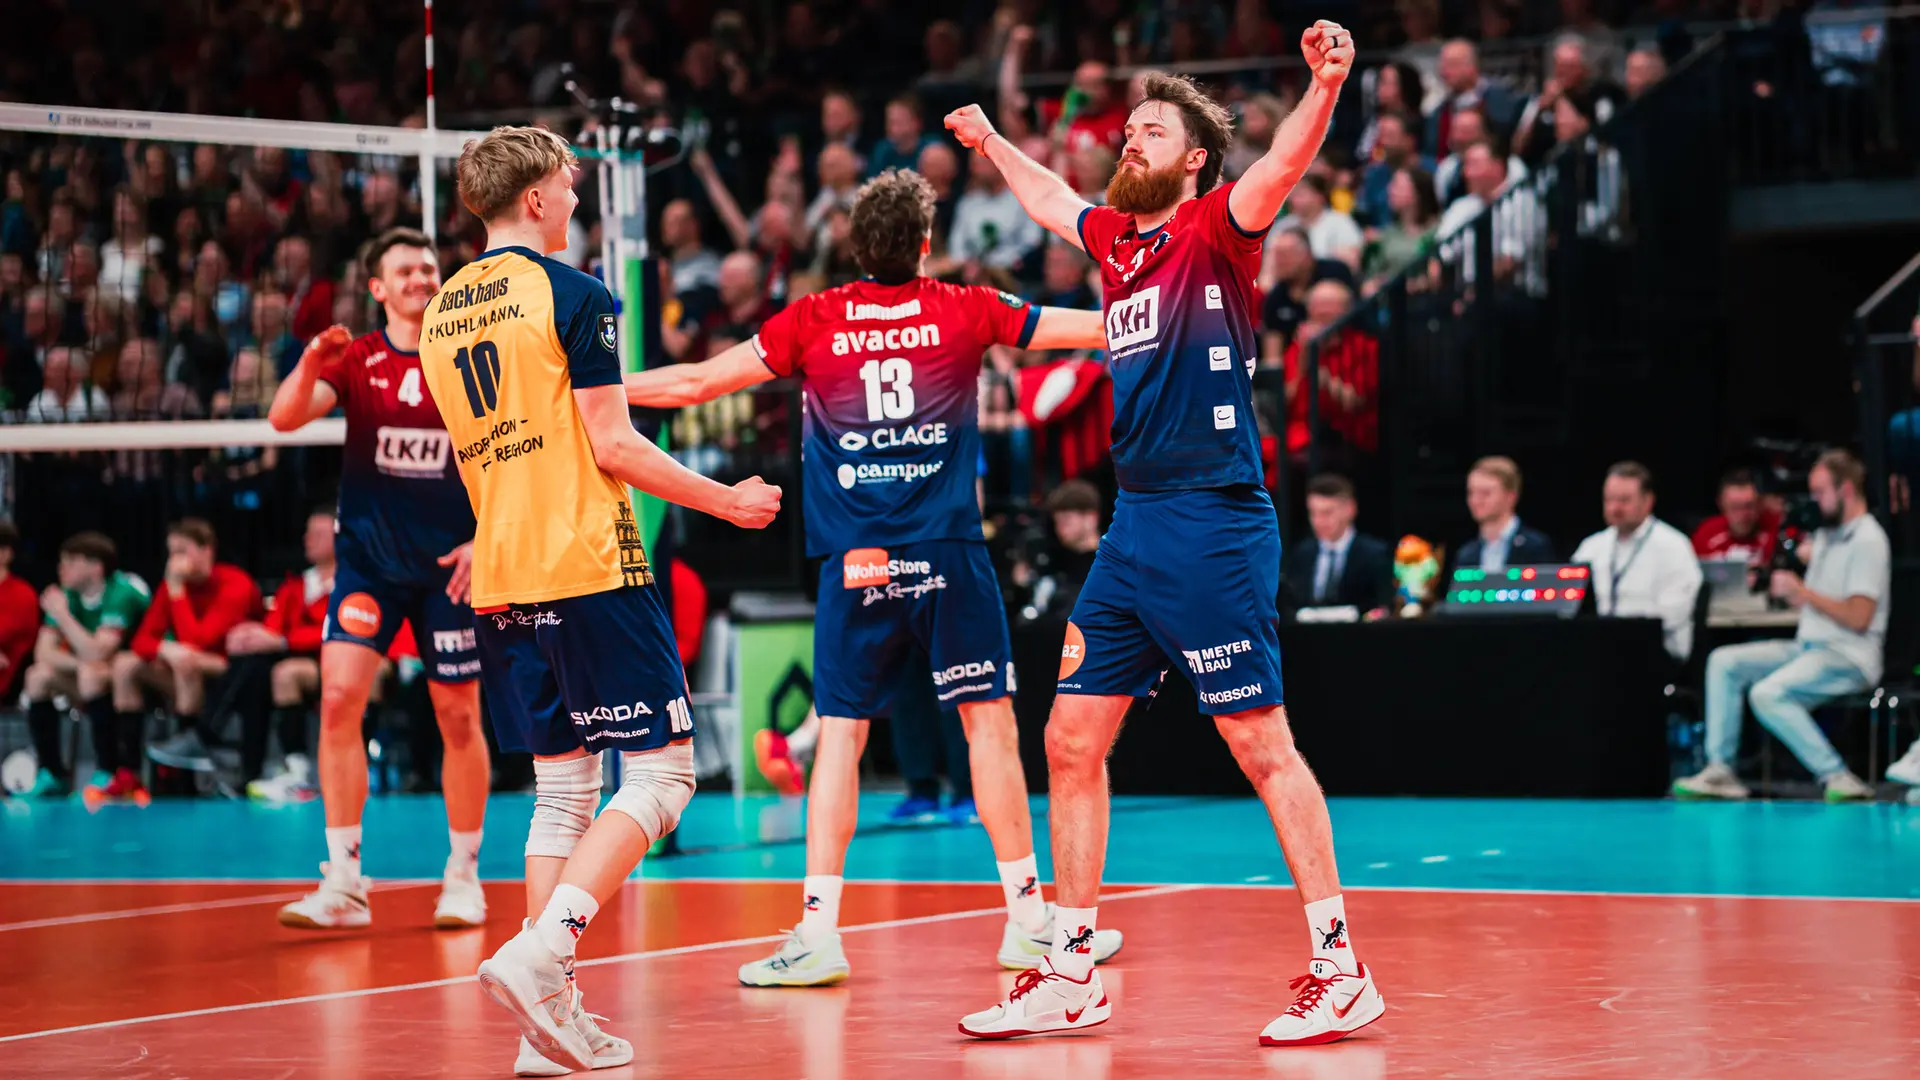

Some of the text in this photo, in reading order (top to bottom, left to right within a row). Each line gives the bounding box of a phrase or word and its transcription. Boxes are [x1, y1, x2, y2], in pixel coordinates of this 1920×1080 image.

[438, 277, 509, 313] Backhaus
[1110, 298, 1152, 340] LKH
[831, 324, 940, 356] avacon
[398, 367, 423, 407] 4
[453, 341, 501, 419] 10
[859, 358, 915, 422] 13
[383, 437, 441, 463] LKH
[871, 423, 948, 449] CLAGE
[844, 560, 931, 580] WohnStore
[1201, 640, 1252, 661] MEYER
[1204, 657, 1232, 673] BAU
[1208, 682, 1263, 704] ROBSON
[570, 701, 654, 726] SKODA
[666, 697, 693, 733] 10
